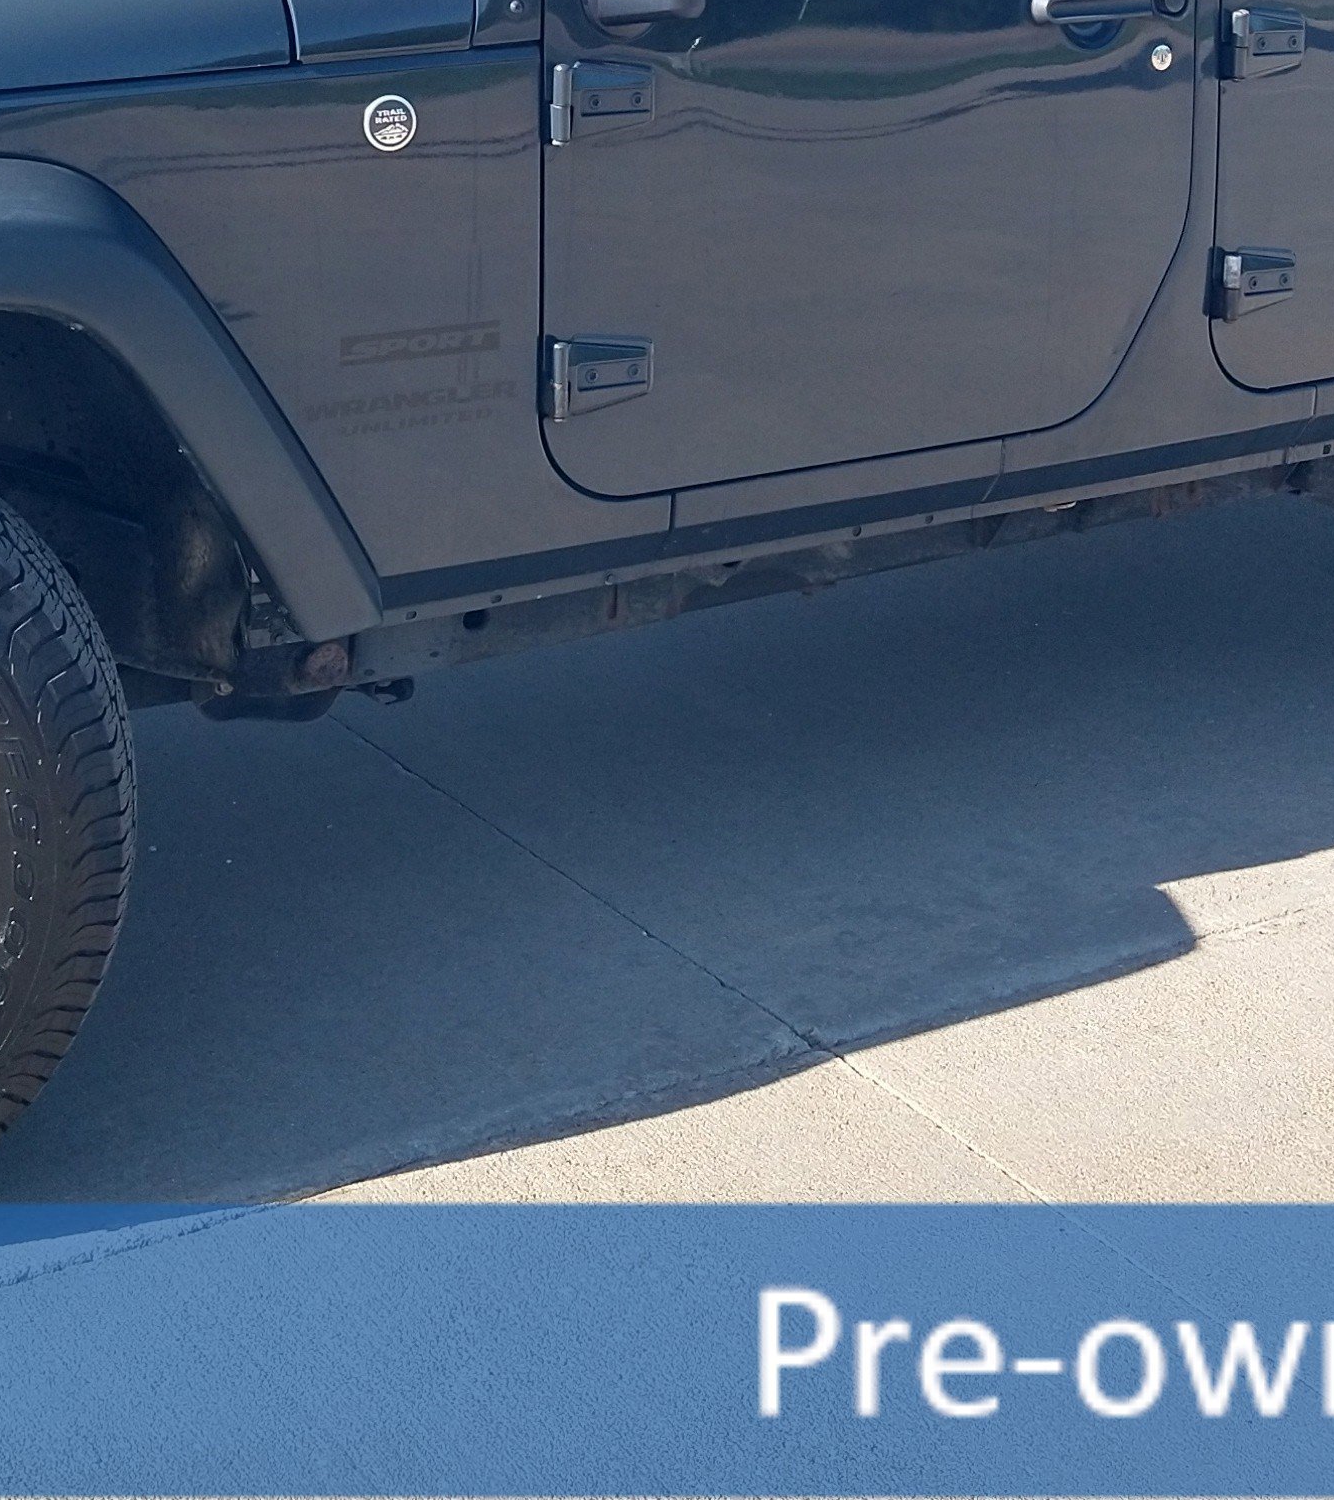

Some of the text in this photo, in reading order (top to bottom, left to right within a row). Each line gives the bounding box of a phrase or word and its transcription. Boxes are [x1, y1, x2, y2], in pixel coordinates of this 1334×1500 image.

[374, 115, 408, 124] RATED
[376, 108, 406, 117] TRAIL
[342, 326, 500, 361] SPORT
[304, 380, 518, 422] WRANGLER
